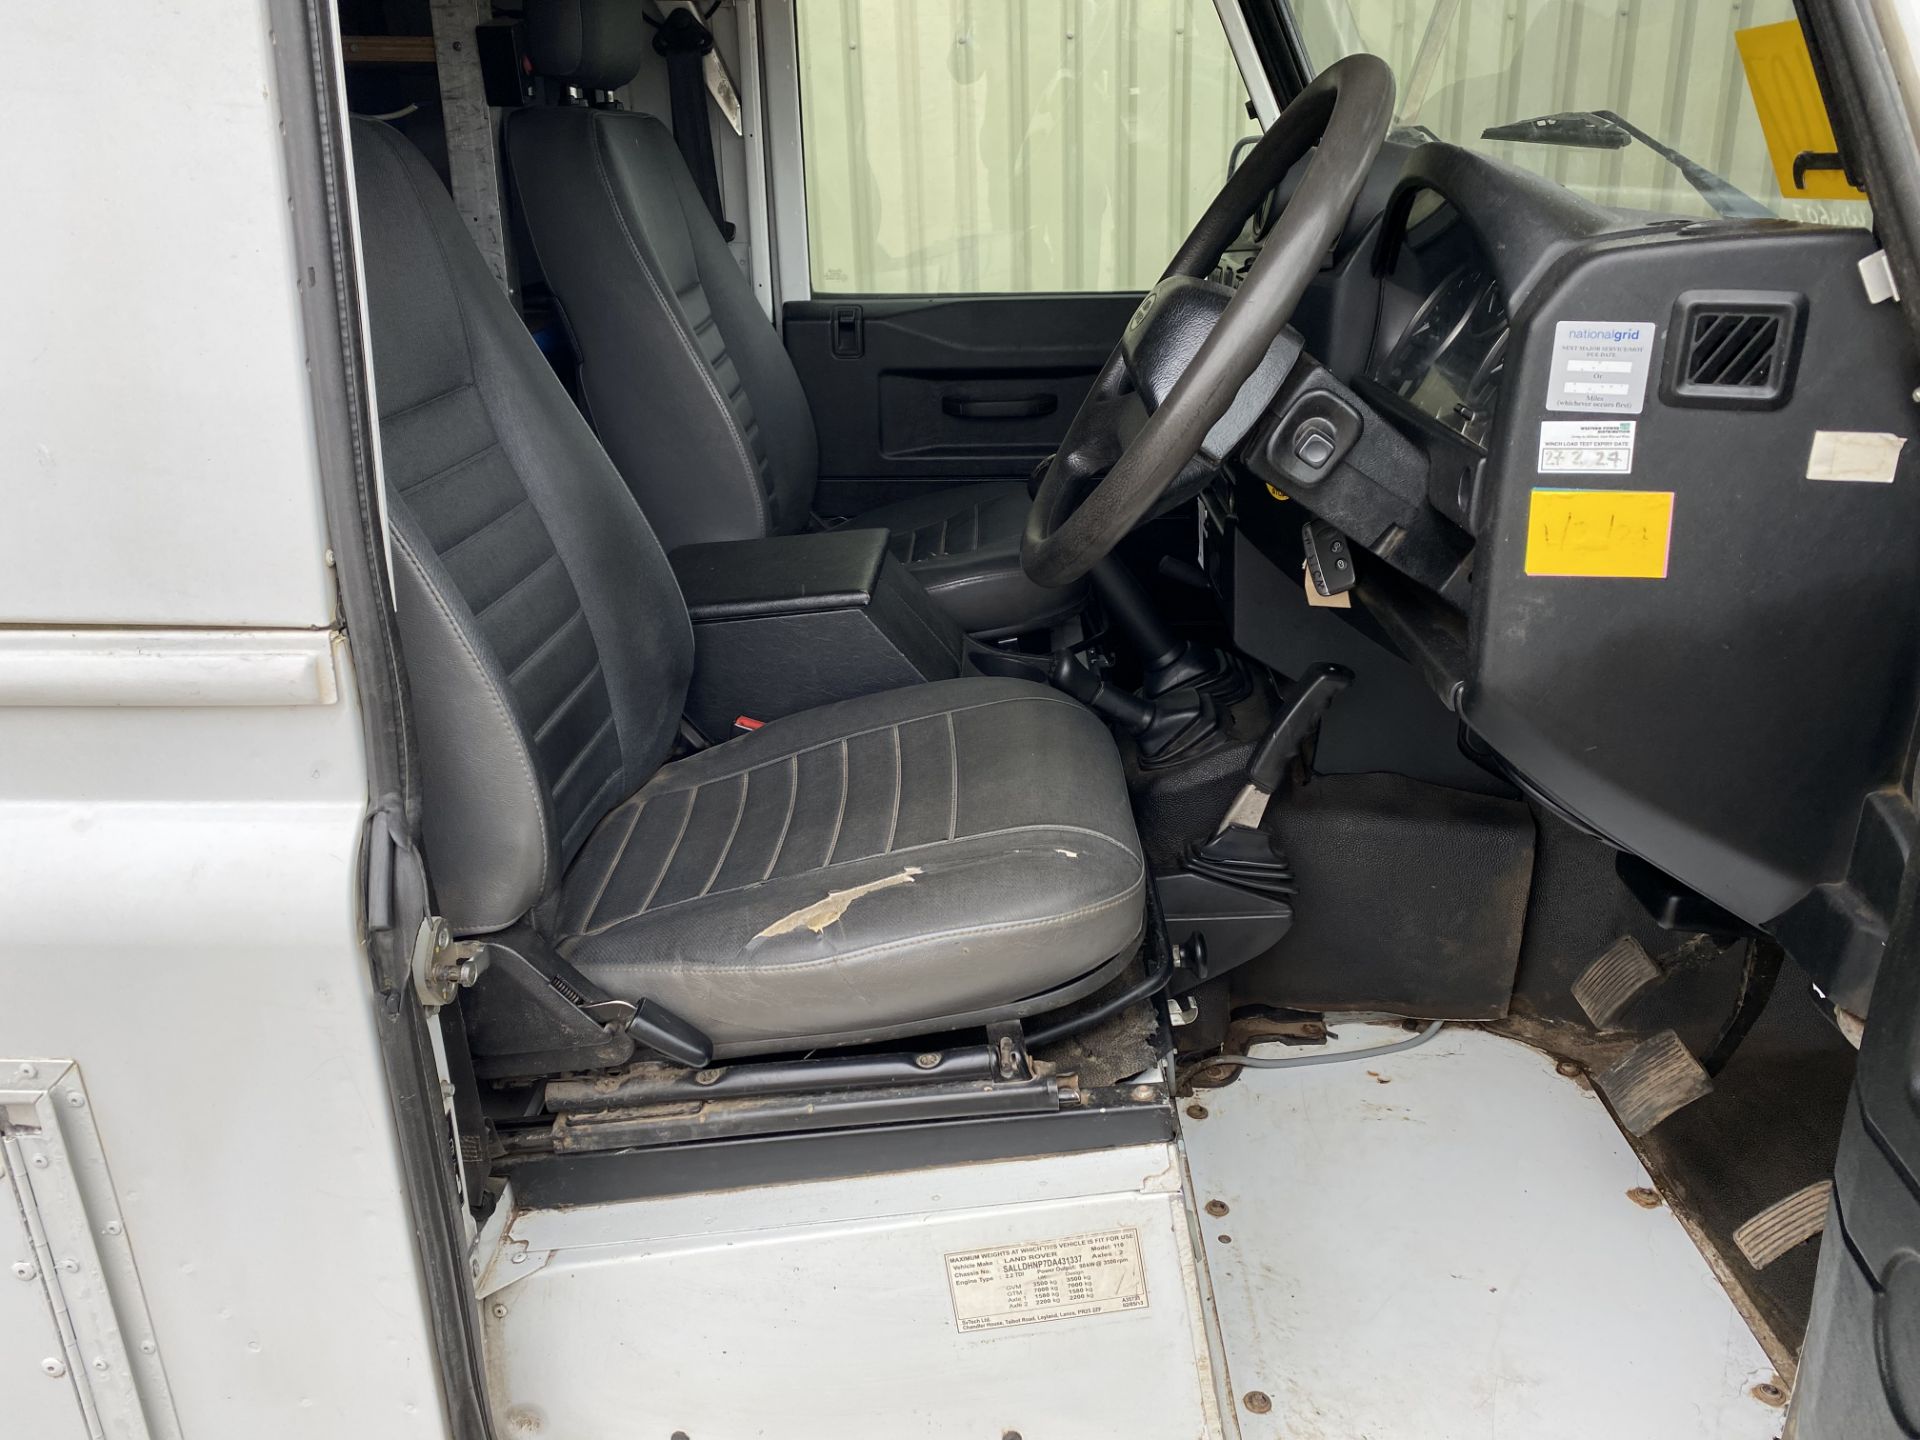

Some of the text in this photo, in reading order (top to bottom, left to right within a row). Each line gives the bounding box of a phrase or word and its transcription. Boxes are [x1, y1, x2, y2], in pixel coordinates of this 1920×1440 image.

[1569, 329, 1640, 342] nationalgrid
[949, 1254, 980, 1263] MAXIMUM
[980, 1250, 1010, 1258] WEIGHTS
[1020, 1245, 1041, 1253] WHICH
[1058, 1239, 1085, 1248] VEHICLE
[1003, 1255, 1026, 1263] LAND
[1028, 1251, 1057, 1259] ROVER
[953, 1269, 979, 1277] Chassis
[1091, 1251, 1112, 1259] Axles
[955, 1277, 977, 1286] Engine
[978, 1275, 994, 1283] Type
